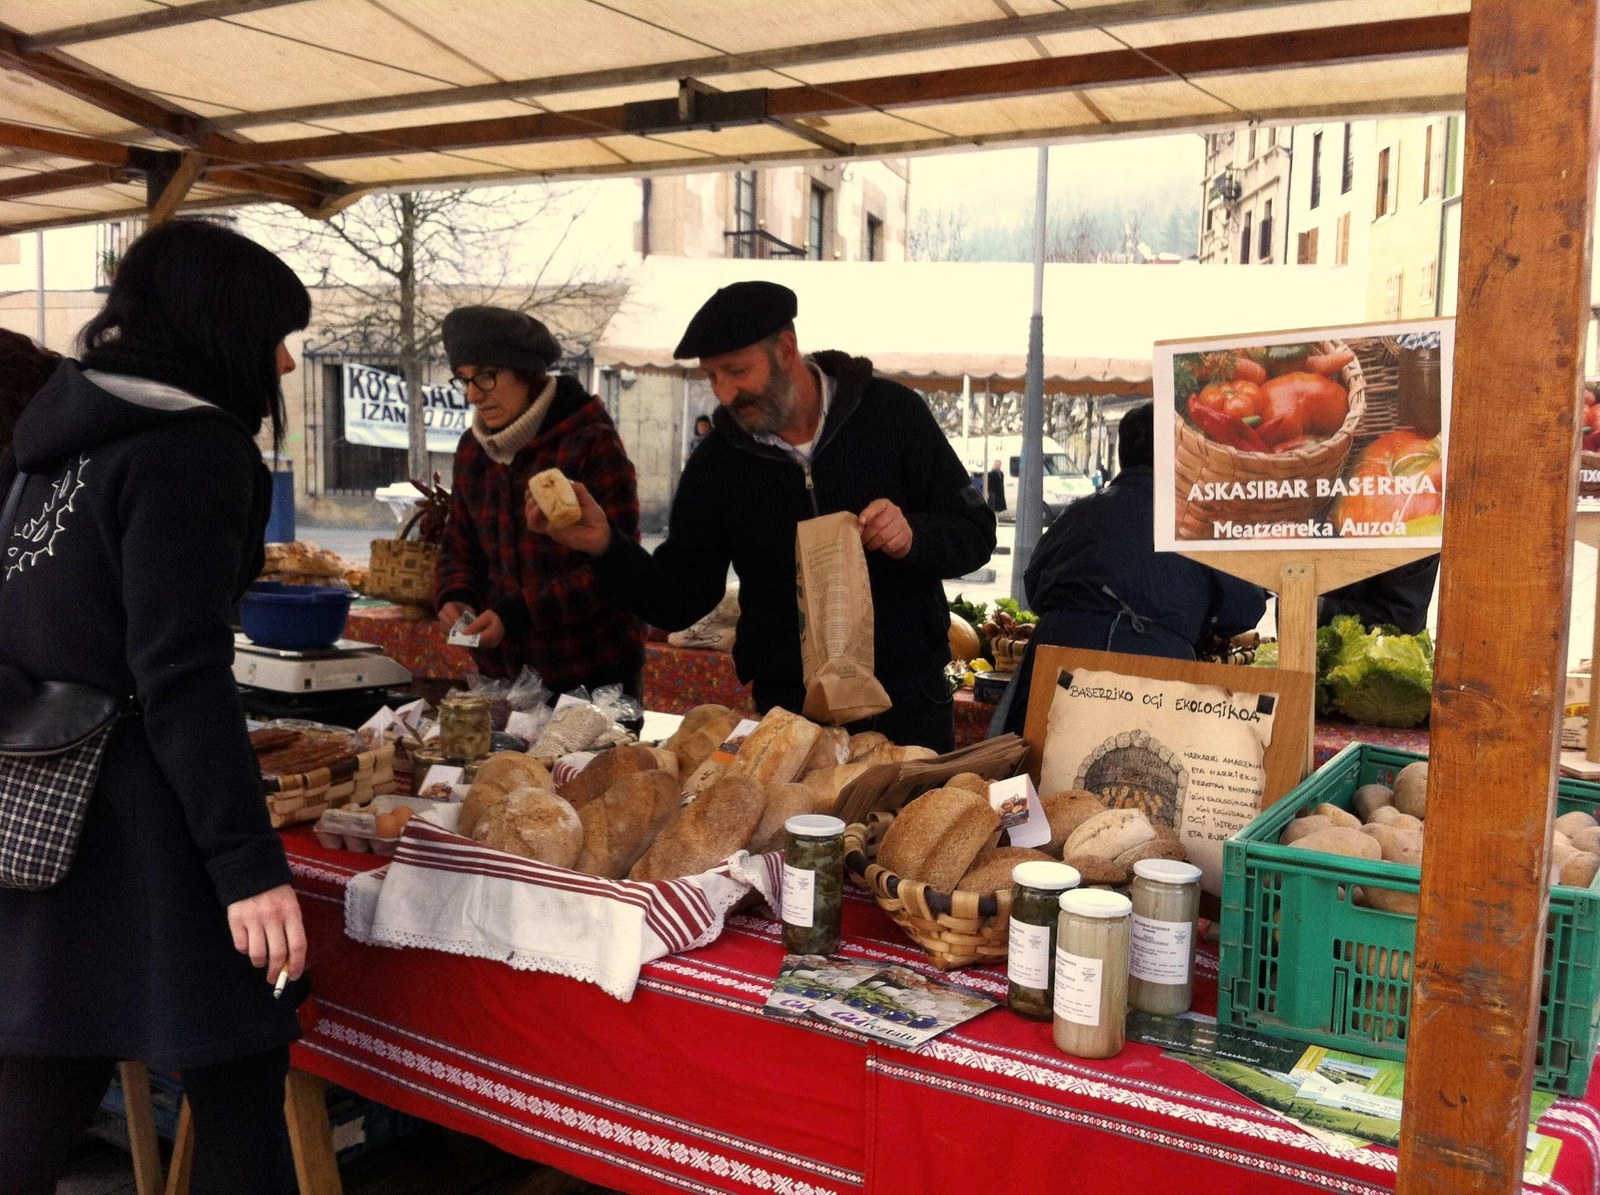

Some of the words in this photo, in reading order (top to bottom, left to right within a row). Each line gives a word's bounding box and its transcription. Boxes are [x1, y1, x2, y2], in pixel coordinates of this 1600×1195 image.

[362, 402, 434, 427] IZANO
[440, 411, 466, 430] DA
[1187, 478, 1309, 502] ASKASIBAR
[1316, 475, 1437, 498] BASERRIA
[1213, 518, 1334, 539] Meatzerreka
[1339, 517, 1407, 536] Auzoa
[1191, 766, 1206, 775] ETA
[1187, 830, 1204, 839] ETA
